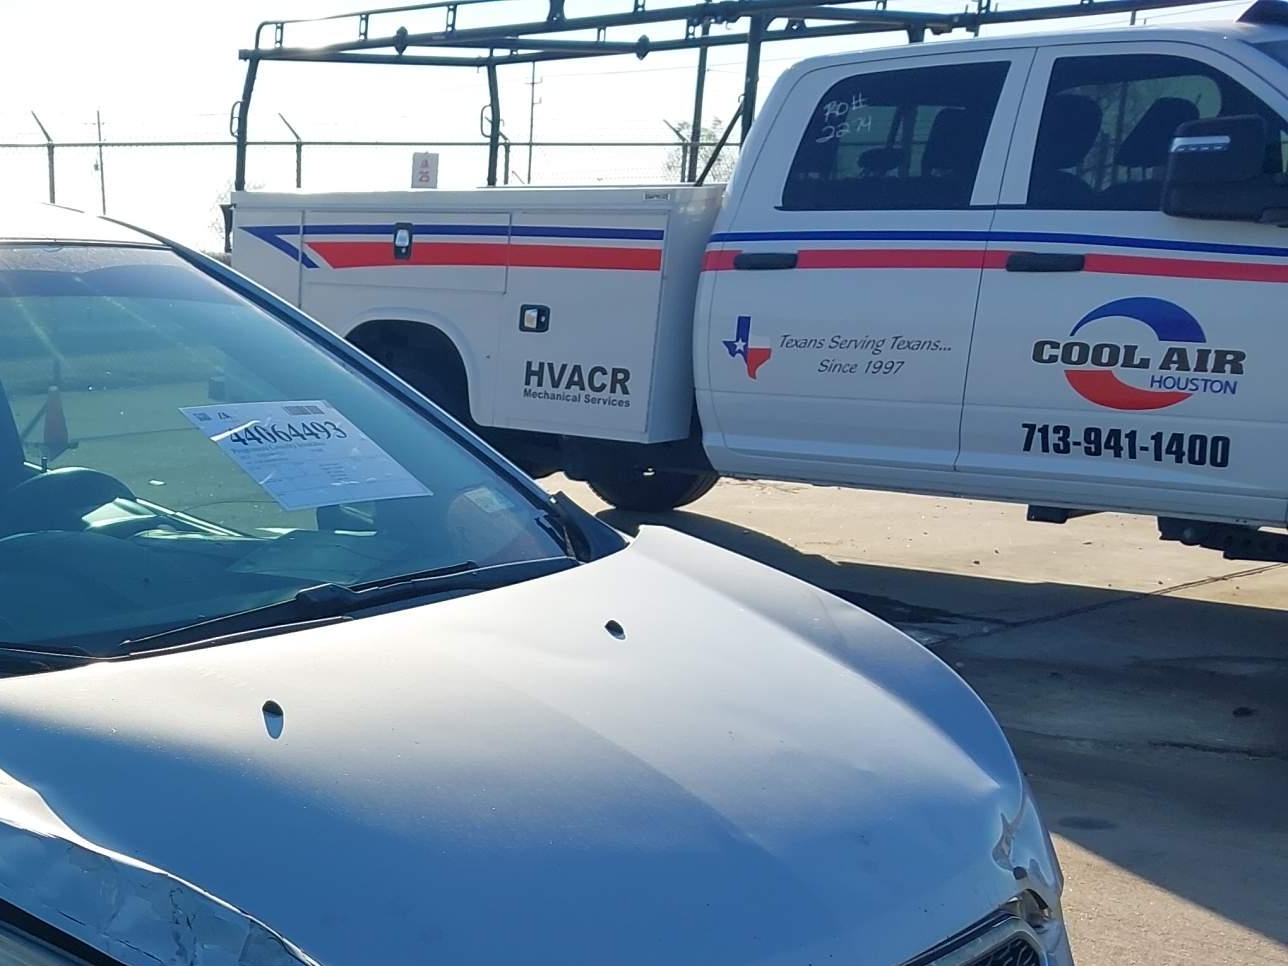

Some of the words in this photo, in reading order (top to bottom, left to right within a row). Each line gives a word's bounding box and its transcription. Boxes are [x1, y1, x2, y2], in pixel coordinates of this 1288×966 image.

[779, 335, 826, 350] Texans
[828, 335, 886, 355] Serving
[890, 335, 952, 351] Texans...
[817, 359, 858, 374] Since
[864, 360, 905, 375] 1997
[1032, 340, 1151, 369] COOL
[1158, 347, 1247, 375] AIR
[524, 360, 631, 395] HVACR
[1150, 375, 1238, 395] HOUSTON
[523, 388, 581, 403] Mechanical
[584, 394, 631, 408] Services
[230, 421, 348, 446] 44064493
[1021, 423, 1231, 468] 713-941-1400
